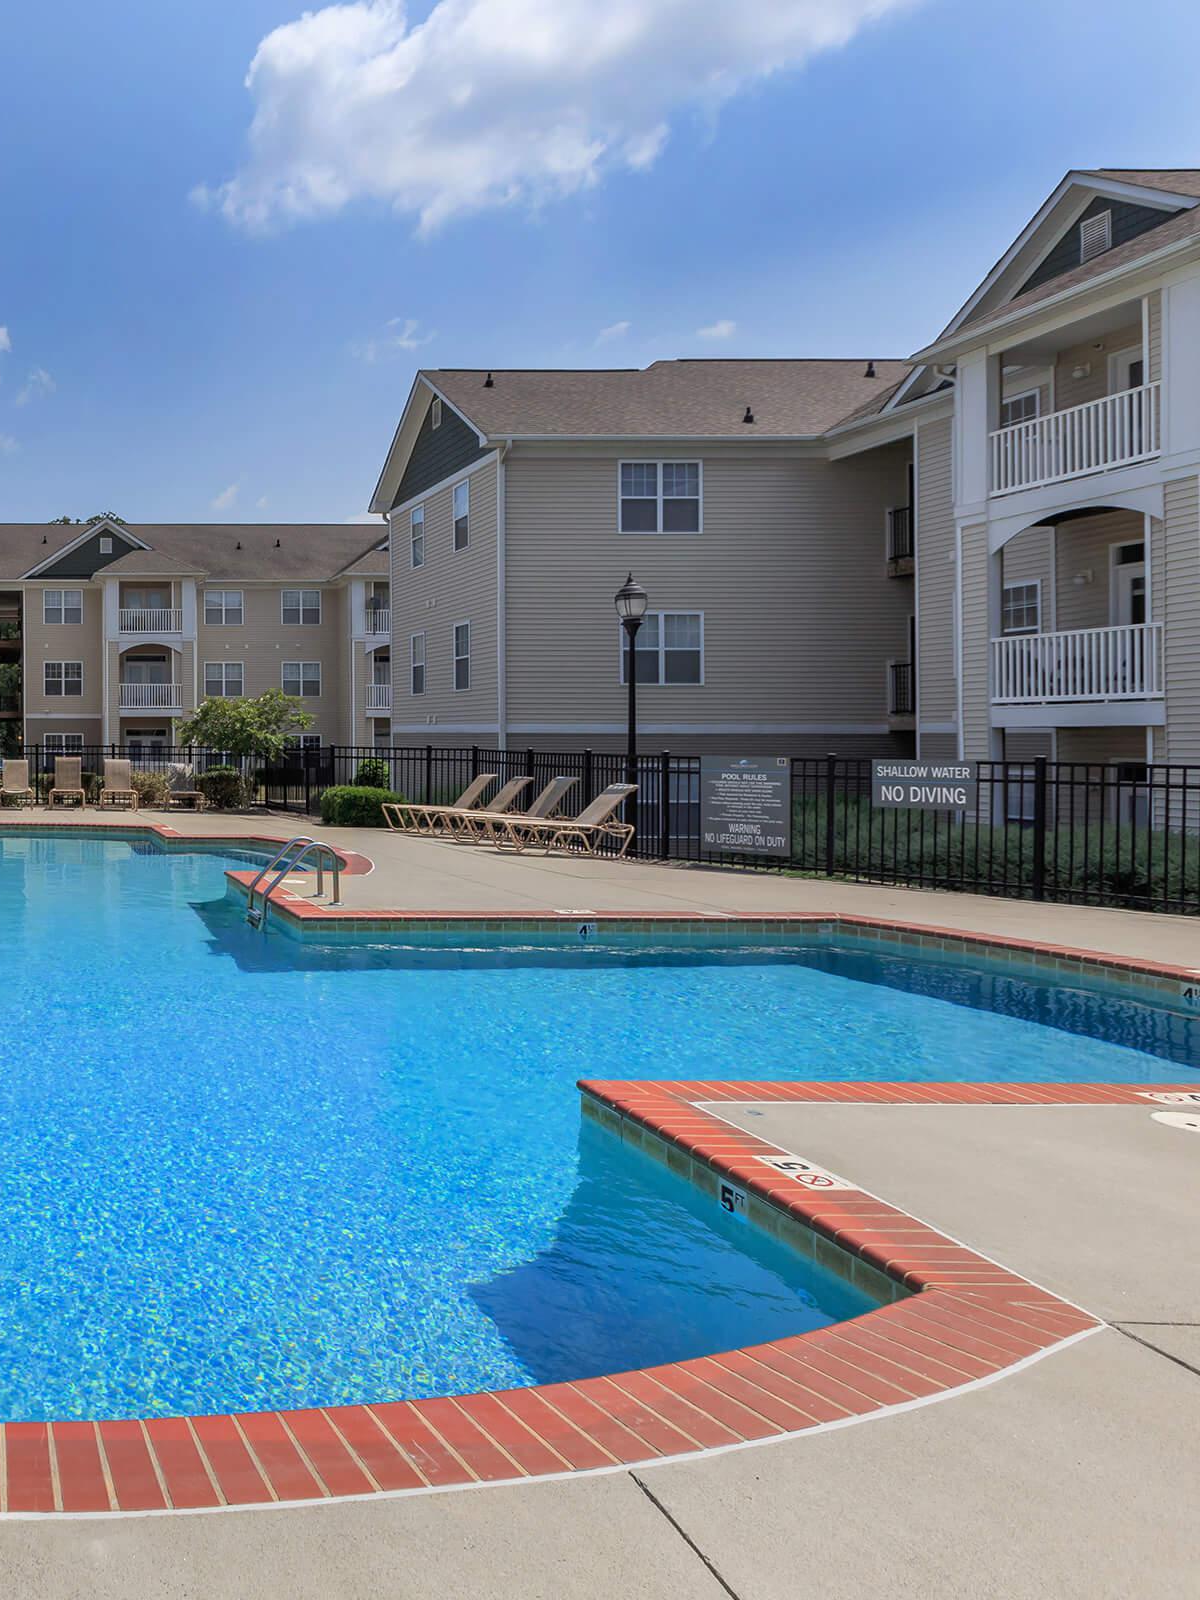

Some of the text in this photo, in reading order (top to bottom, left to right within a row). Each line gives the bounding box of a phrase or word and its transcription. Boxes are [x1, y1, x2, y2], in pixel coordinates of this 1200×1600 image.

[721, 773, 740, 781] POOL
[877, 766, 970, 778] SHALLOW WATER
[881, 785, 967, 804] NO DIVING
[728, 823, 761, 834] WARNING
[704, 832, 715, 843] NO
[716, 833, 753, 845] LIFEGUARD
[754, 836, 765, 846] ON
[766, 836, 786, 848] DUTY
[772, 1162, 809, 1170] 5
[720, 1184, 745, 1213] 5 FT
